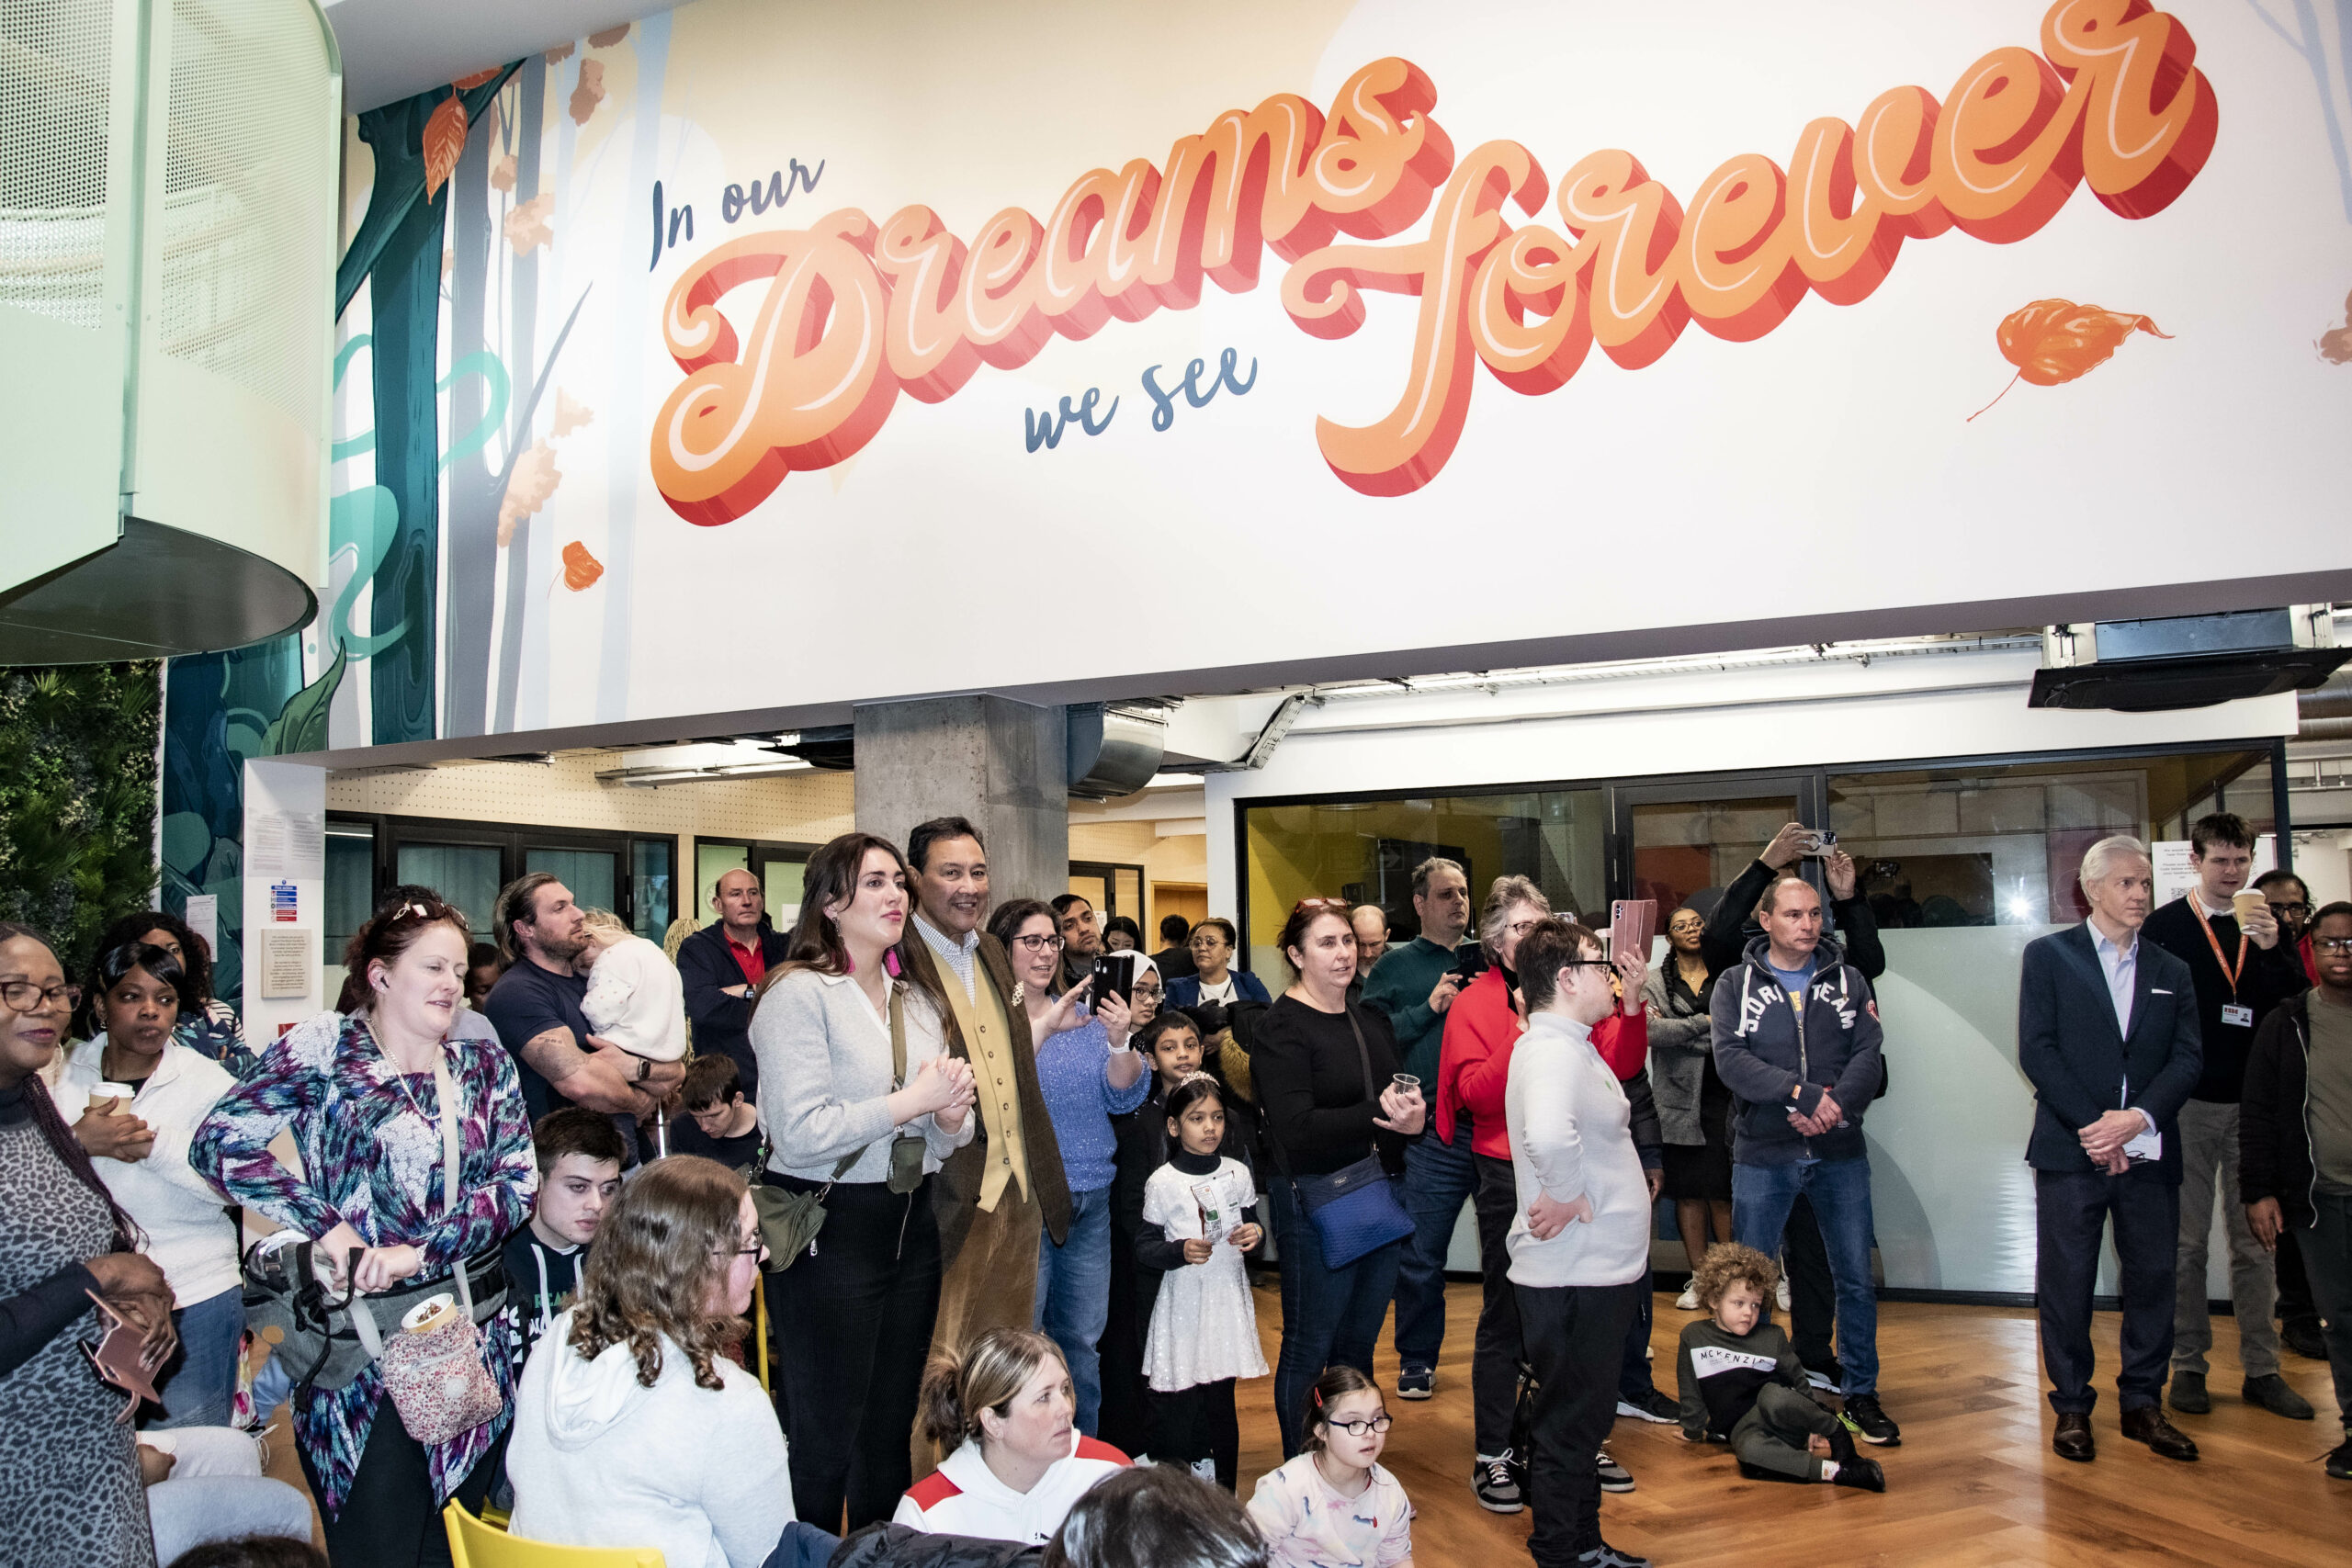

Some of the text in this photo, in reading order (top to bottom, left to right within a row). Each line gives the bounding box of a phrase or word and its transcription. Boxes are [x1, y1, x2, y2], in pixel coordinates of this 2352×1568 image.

[650, 157, 825, 274] In our
[1280, 0, 2220, 498] forever
[650, 57, 1455, 527] Dreams
[1024, 346, 1258, 455] we see
[1812, 981, 1857, 1030] TEAM
